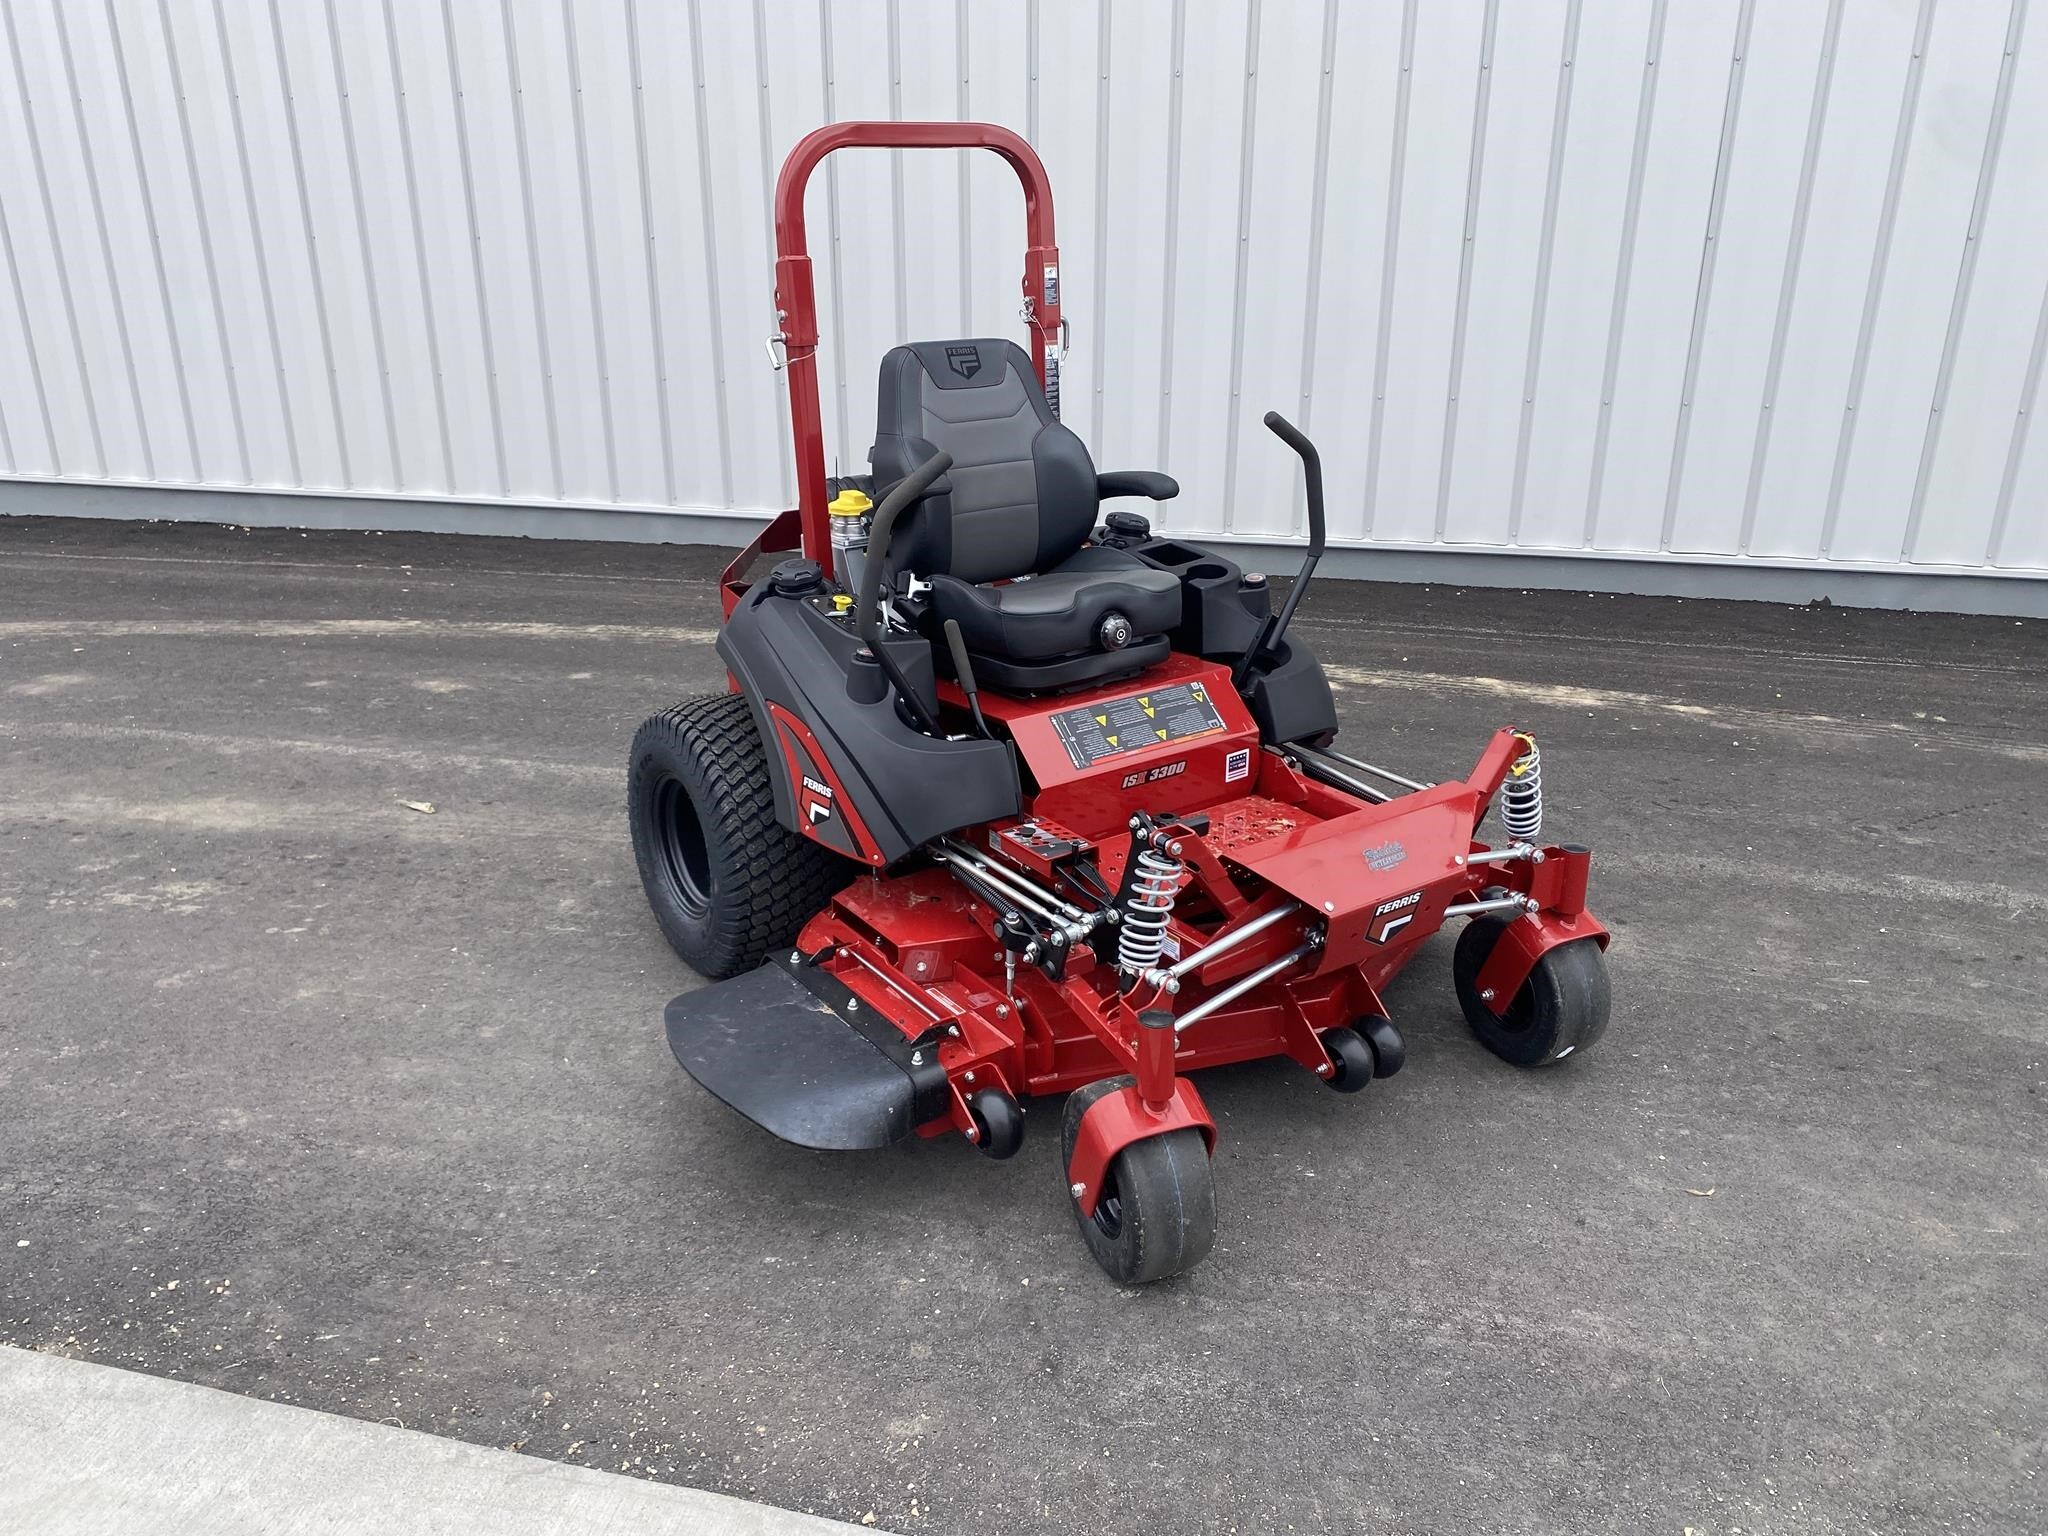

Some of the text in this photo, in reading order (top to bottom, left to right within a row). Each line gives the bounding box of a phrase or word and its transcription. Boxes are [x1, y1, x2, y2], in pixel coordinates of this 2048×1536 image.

[948, 347, 976, 355] FERRIS
[1149, 761, 1186, 781] 3300
[803, 776, 833, 798] FERRIS
[1375, 892, 1421, 916] FERRIS
